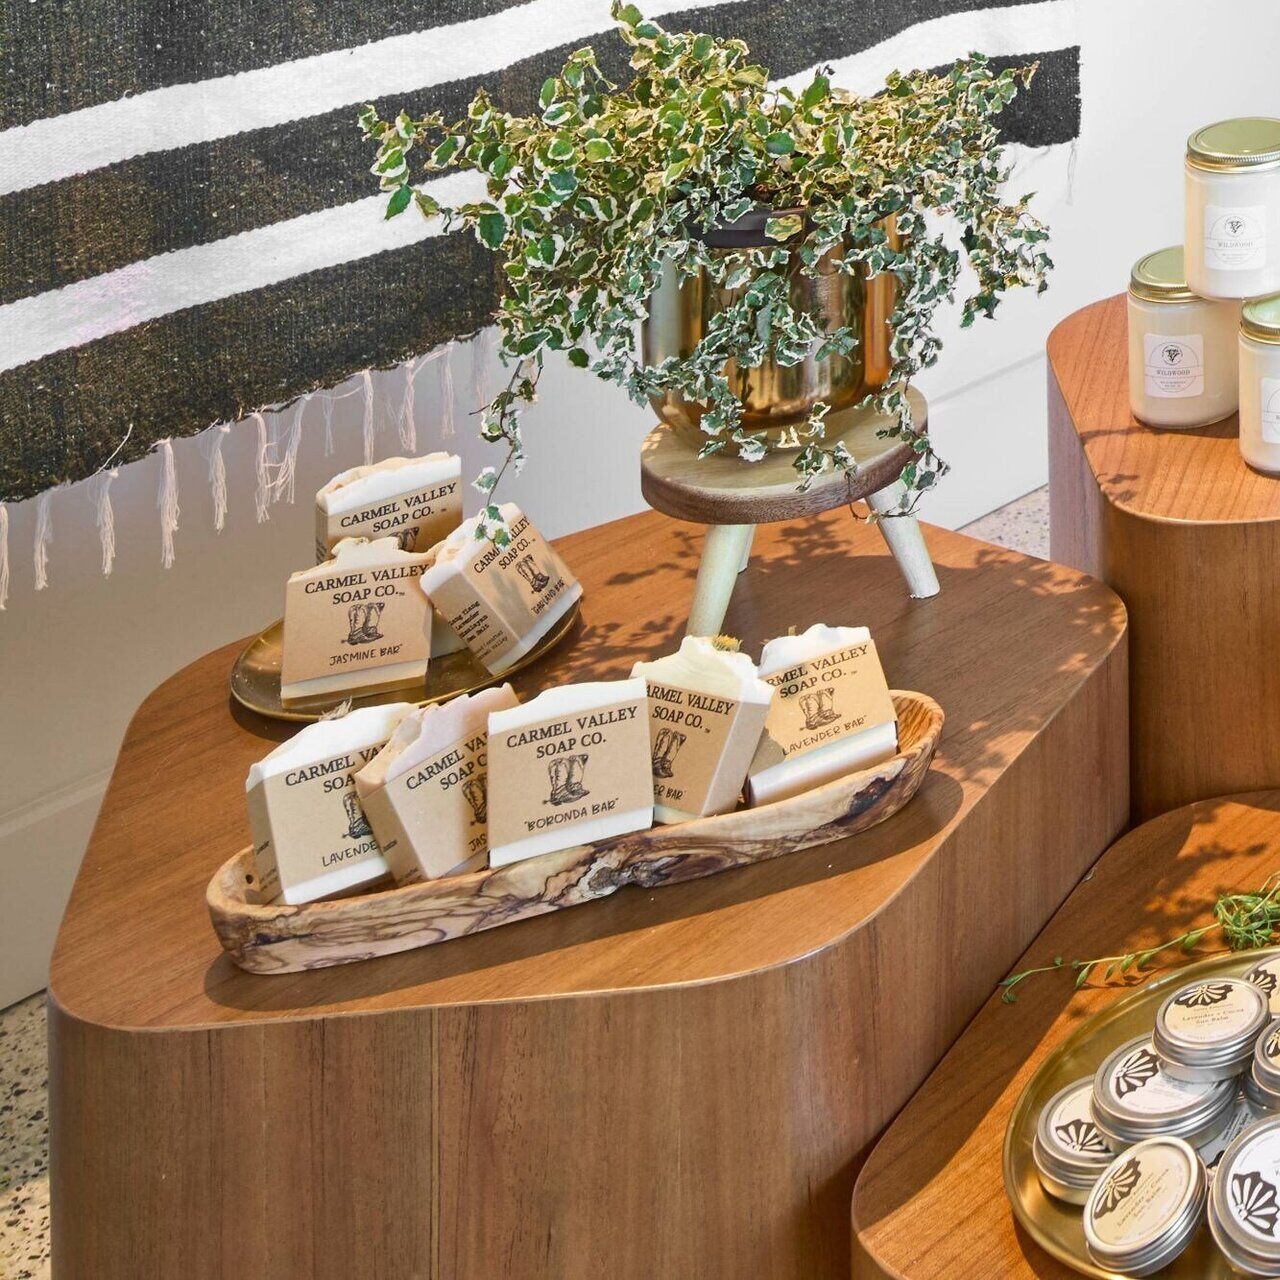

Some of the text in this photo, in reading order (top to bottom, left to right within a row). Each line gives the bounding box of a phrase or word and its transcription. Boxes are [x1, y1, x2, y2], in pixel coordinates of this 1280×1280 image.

[340, 482, 456, 528] CARMEL VALLEY
[372, 506, 435, 532] SOAP CO.
[474, 546, 500, 574] CARM
[498, 538, 531, 570] SOAP CO.
[304, 564, 430, 594] CARMEL VALLEY
[332, 584, 399, 605] SOAP CO.
[330, 648, 376, 666] JASMINE
[766, 644, 869, 687] RMEL VALLEY
[780, 668, 848, 699] SOAP CO.
[646, 684, 735, 716] ARMEL VALLEY
[506, 722, 572, 748] CARMEL
[576, 706, 638, 730] VALLEY
[652, 706, 704, 730] SOAP CO.
[536, 732, 606, 759] SOAP CO.
[782, 725, 840, 756] LAVENDER
[284, 755, 356, 787] CARMEL
[323, 774, 356, 794] SOA
[406, 750, 465, 790] CARMEL
[440, 761, 475, 791] SOAP
[322, 840, 380, 868] LAVENDE
